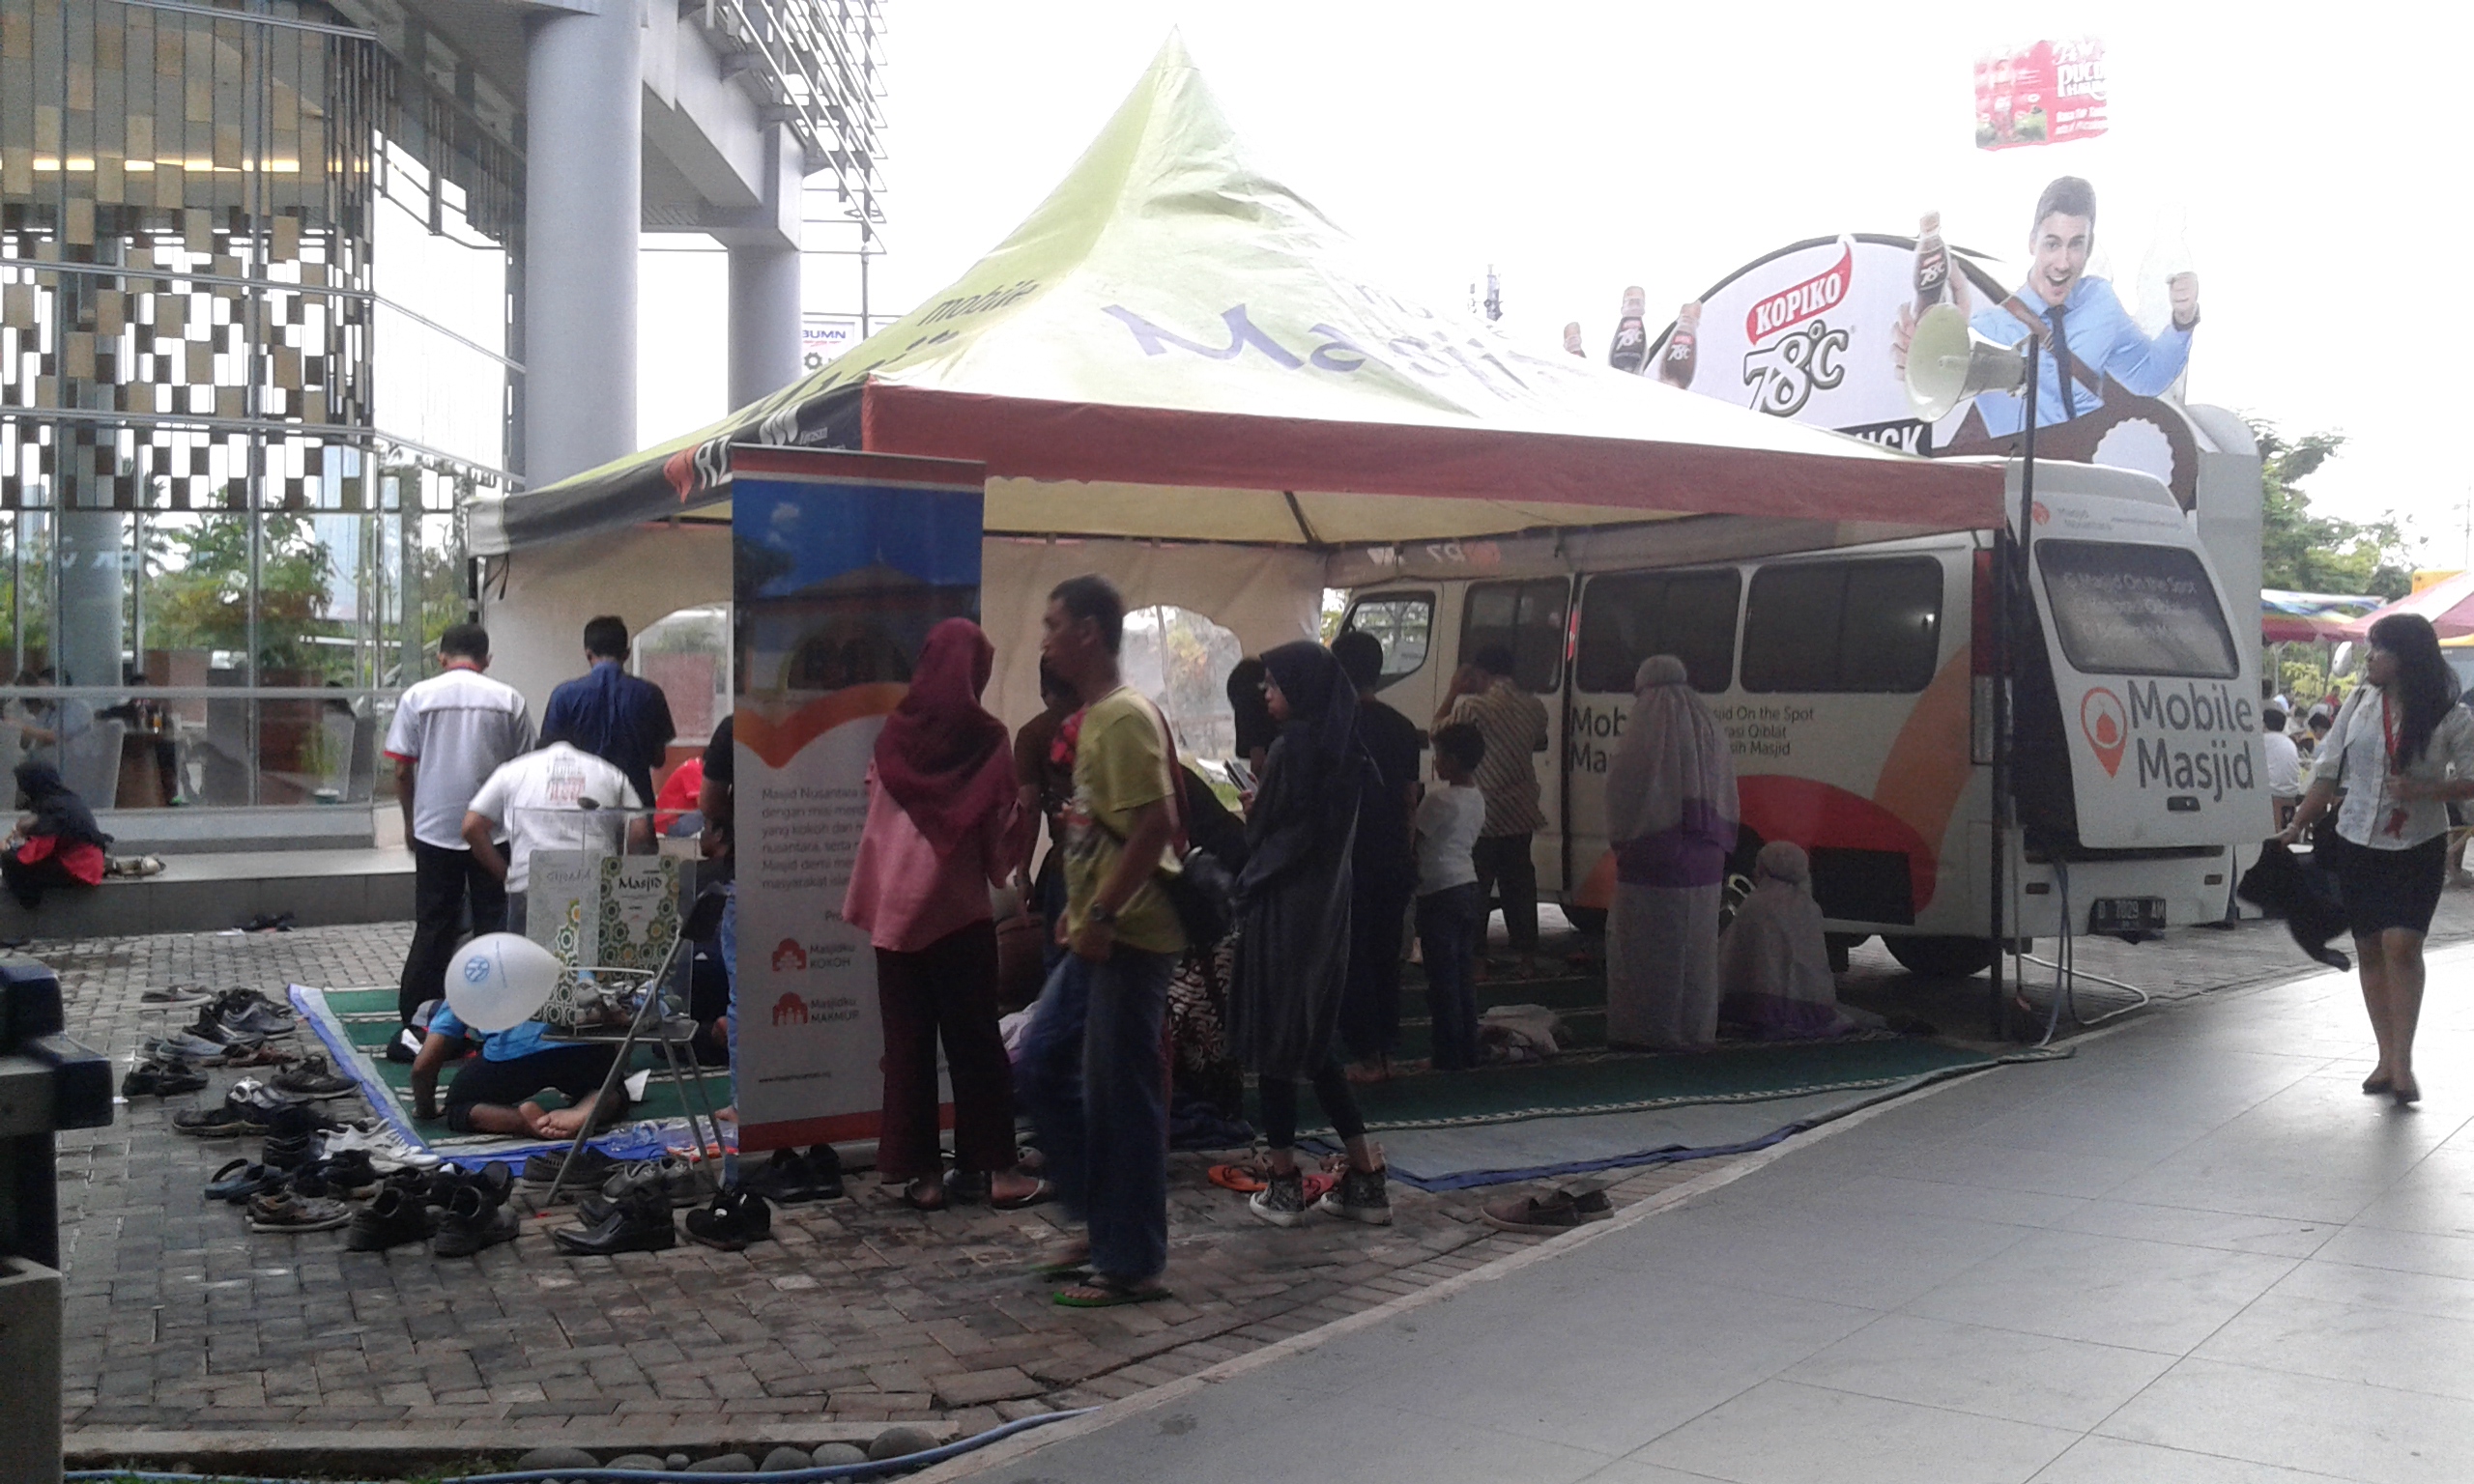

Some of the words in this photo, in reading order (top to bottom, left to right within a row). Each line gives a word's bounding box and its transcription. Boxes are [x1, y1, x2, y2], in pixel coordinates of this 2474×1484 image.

[1755, 272, 1842, 335] KOPIKO
[2127, 679, 2255, 732] Mobile
[1737, 708, 1756, 721] On
[1760, 707, 1780, 721] the
[1784, 708, 1815, 725] Spot
[1748, 725, 1787, 739] Qiblat
[1750, 742, 1791, 758] Masjid
[2137, 737, 2255, 803] Masjid
[618, 876, 663, 892] Masjid
[810, 943, 855, 956] Masjidku
[810, 957, 850, 969] KOKOH
[810, 998, 857, 1012] Masjidku
